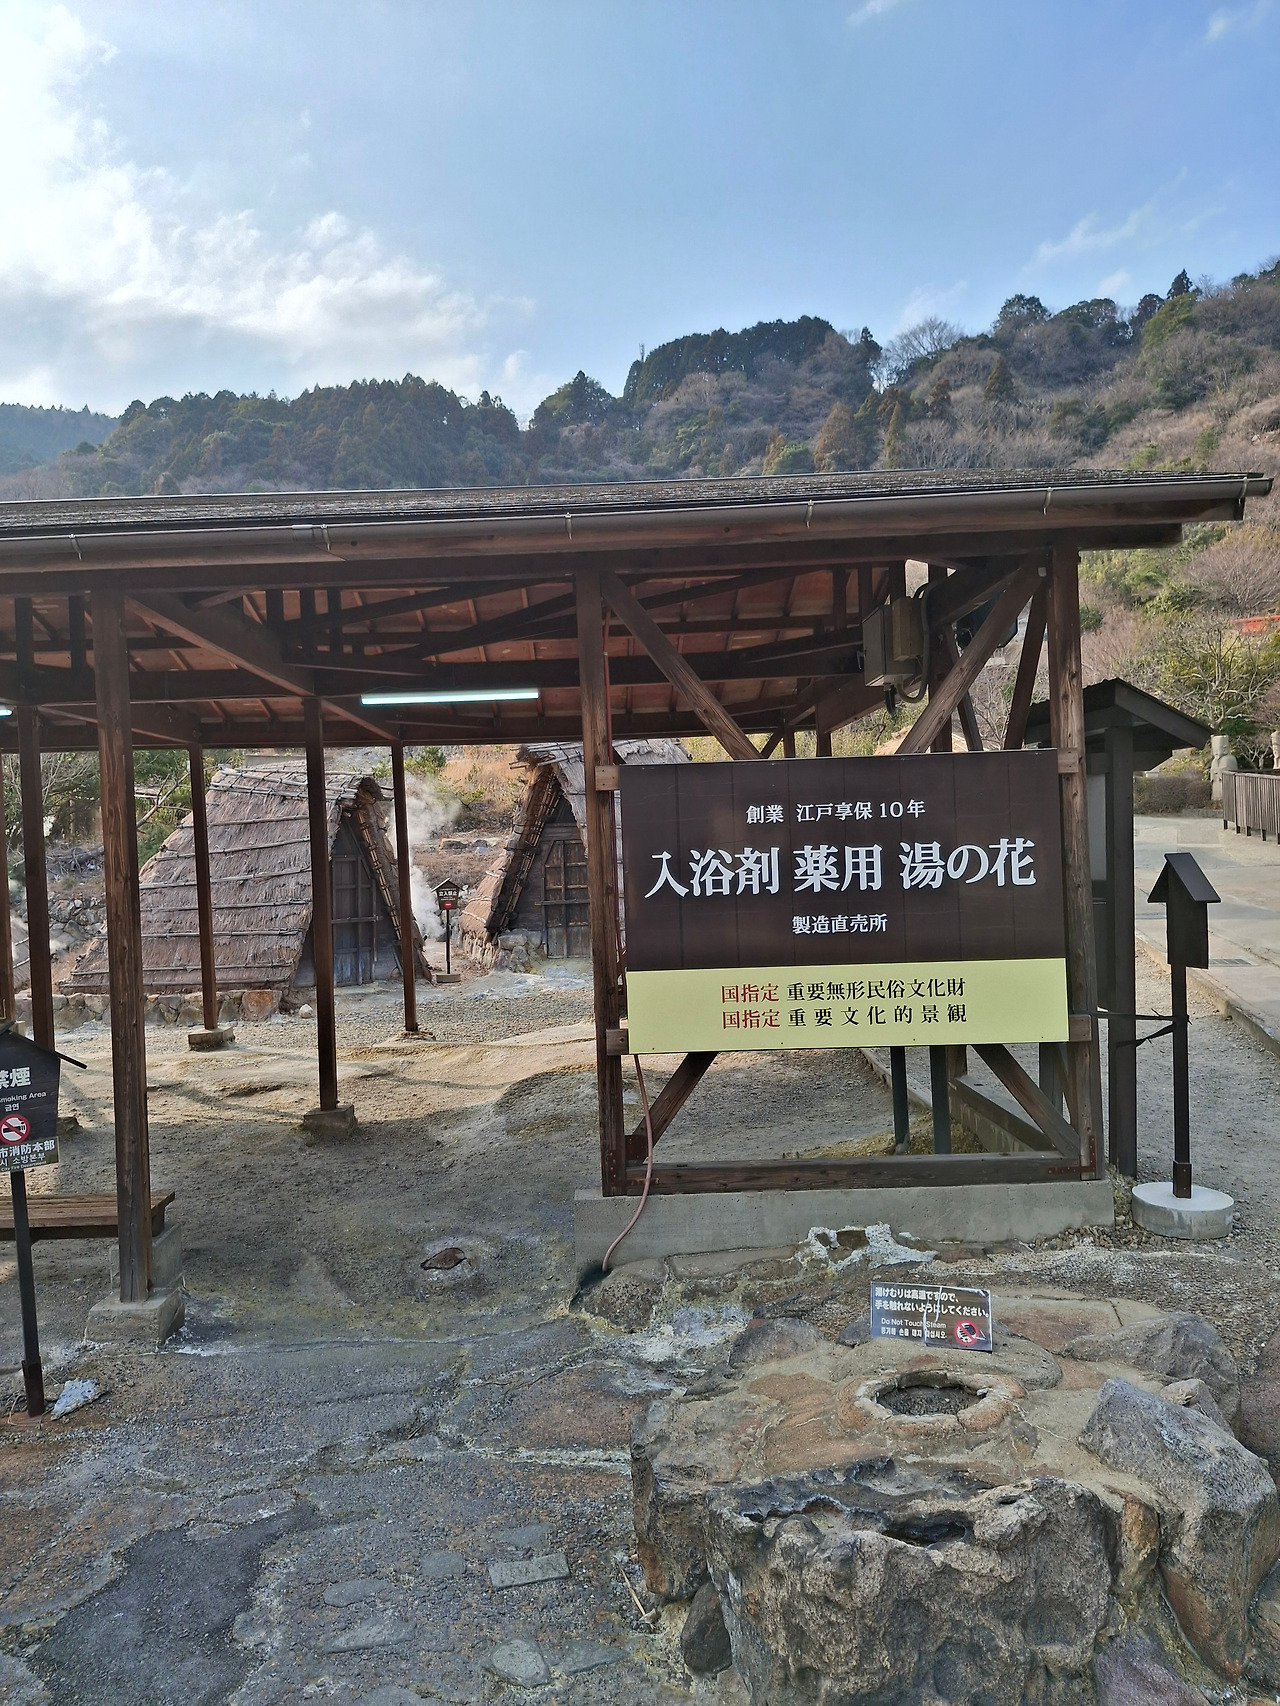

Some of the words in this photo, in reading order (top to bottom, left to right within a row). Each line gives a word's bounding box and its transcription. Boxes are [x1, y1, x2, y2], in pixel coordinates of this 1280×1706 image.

[745, 804, 785, 825] 創業
[644, 846, 780, 899] 入浴剤
[792, 843, 883, 893] 薬用
[898, 837, 1037, 890] 湯の花
[792, 913, 888, 935] 製造直売所
[721, 982, 780, 1004] 国指定
[786, 977, 966, 1002] 重要無形民俗文化財
[722, 1008, 781, 1030] 国指定
[787, 1003, 967, 1028] 重要文化的景観
[0, 1094, 28, 1103] moking
[29, 1091, 47, 1099] Area
[5, 1102, 20, 1112] 금연
[12, 1152, 46, 1165] 소방본부
[881, 1317, 890, 1325] Do
[891, 1318, 903, 1326] Not
[926, 1321, 947, 1329] Steam
